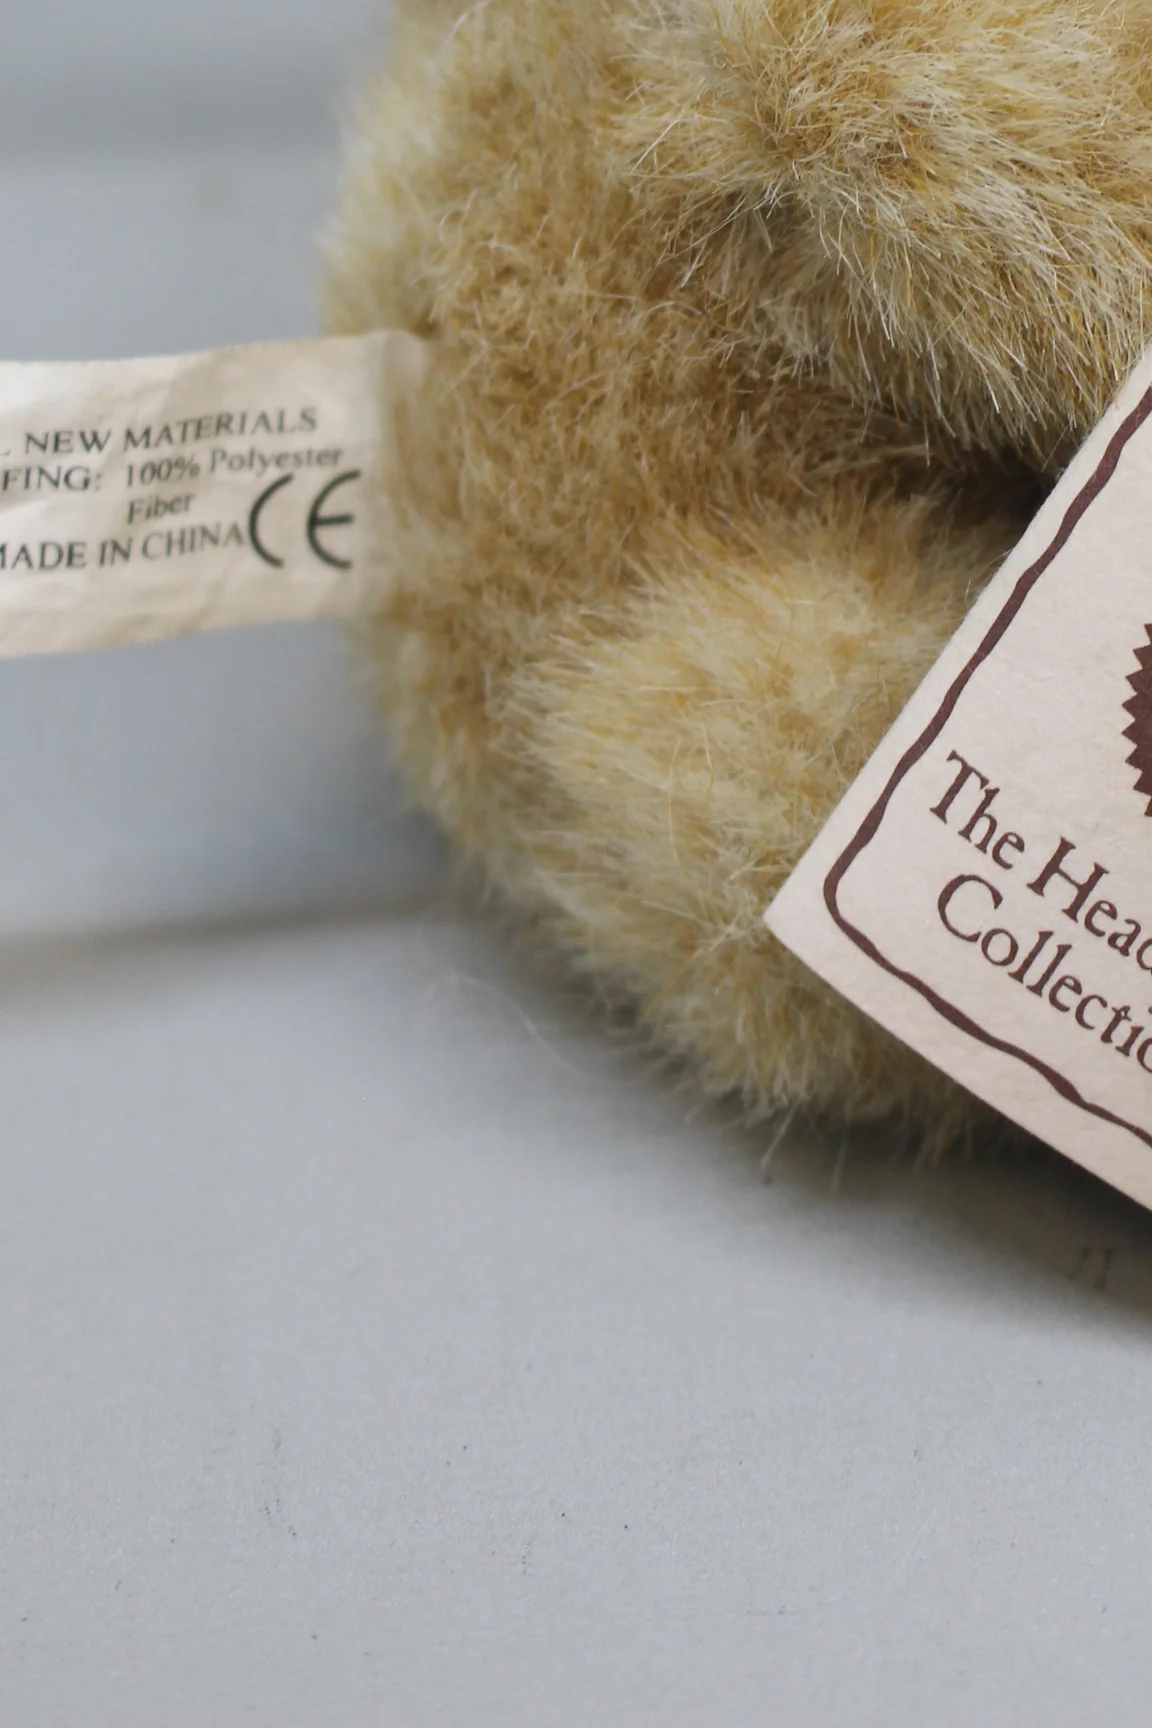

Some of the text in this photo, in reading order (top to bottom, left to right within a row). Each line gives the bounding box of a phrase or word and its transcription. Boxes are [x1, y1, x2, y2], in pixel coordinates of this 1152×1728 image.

[25, 406, 318, 455] NEW MATERIALS
[126, 456, 199, 488] 100%
[208, 445, 343, 479] Polyester
[126, 492, 195, 525] Fiber
[0, 521, 244, 571] ADE IN CHINA
[929, 750, 1026, 870] The
